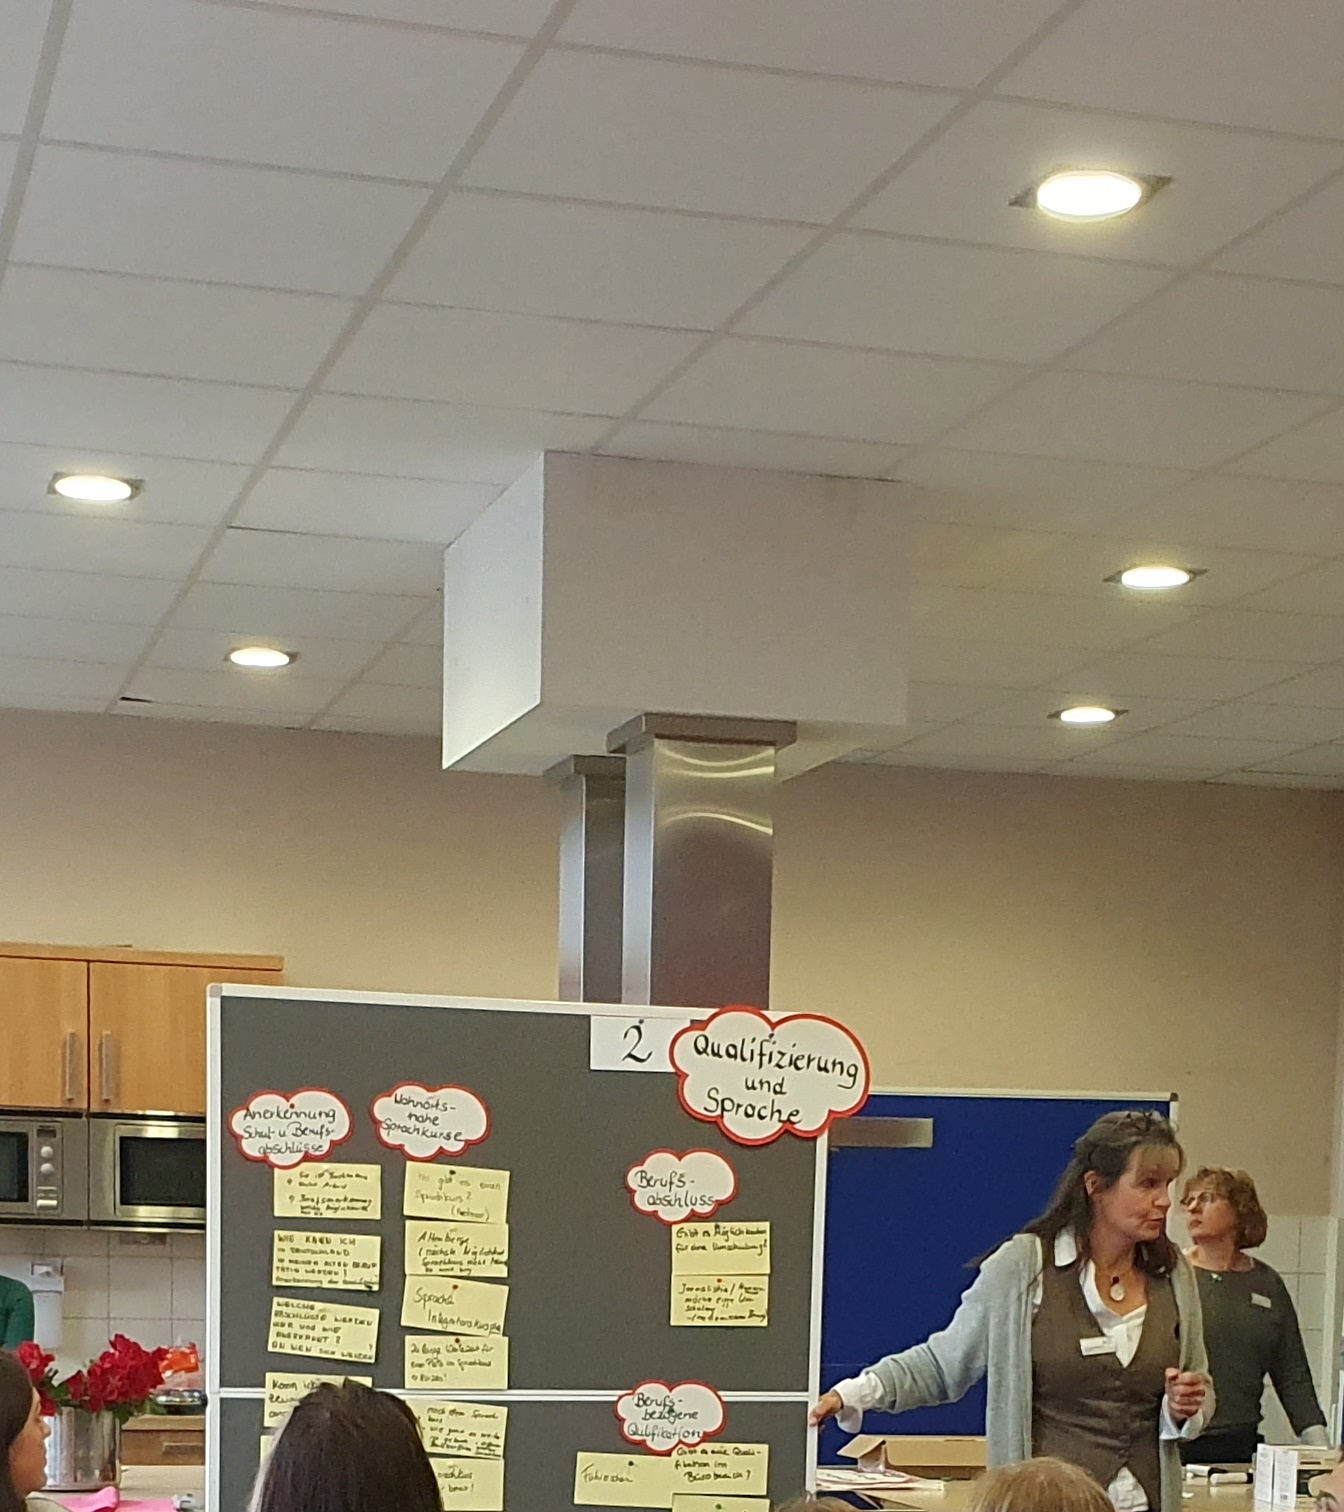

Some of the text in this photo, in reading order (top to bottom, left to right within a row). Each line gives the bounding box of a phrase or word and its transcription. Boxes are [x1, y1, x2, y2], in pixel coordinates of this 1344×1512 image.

[622, 1023, 653, 1064] 2
[693, 1034, 859, 1089] Qualifizierung
[745, 1076, 787, 1095] und
[243, 1106, 336, 1122] Anerkennung
[703, 1087, 802, 1125] Sprache
[408, 1111, 439, 1126] nahe
[381, 1117, 466, 1142] Sprachkurse
[634, 1169, 696, 1192] Berufs-
[647, 1193, 716, 1208] abschluss
[633, 1392, 683, 1409] Berufs-
[641, 1409, 699, 1425] bezogene
